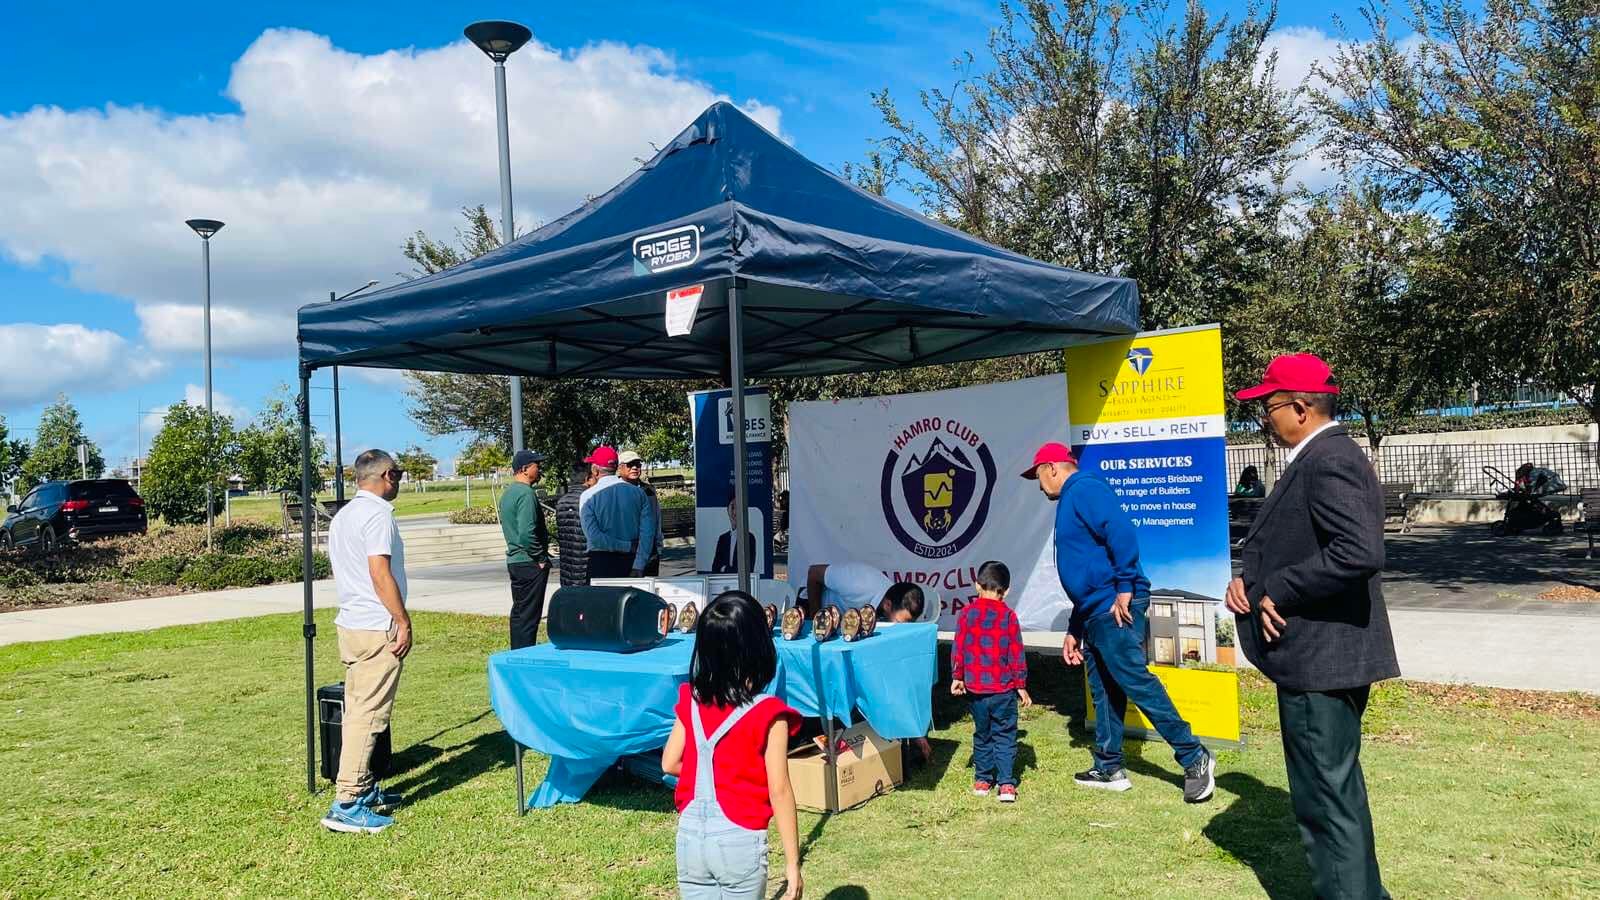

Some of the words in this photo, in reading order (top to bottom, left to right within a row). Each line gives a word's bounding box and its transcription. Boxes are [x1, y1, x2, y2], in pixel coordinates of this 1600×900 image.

[640, 235, 691, 258] RIDGE
[651, 250, 691, 266] RYDER
[1099, 376, 1185, 398] SAPPHIRE
[894, 417, 942, 450] HAMRO
[946, 419, 980, 447] CLUB
[1082, 429, 1110, 441] BUY
[1123, 426, 1156, 438] SELL
[1170, 422, 1207, 435] RENT
[1100, 459, 1128, 471] OUR
[1129, 456, 1193, 469] SERVICES
[1122, 476, 1139, 487] plan
[1141, 475, 1166, 485] across
[1167, 474, 1203, 484] Brisbane
[1126, 488, 1148, 498] range
[1150, 487, 1158, 496] of
[1159, 486, 1191, 496] Builders
[1131, 503, 1139, 511] to
[1140, 503, 1162, 511] move
[1163, 502, 1170, 511] in
[1171, 502, 1197, 511] house
[1142, 517, 1194, 528] Management
